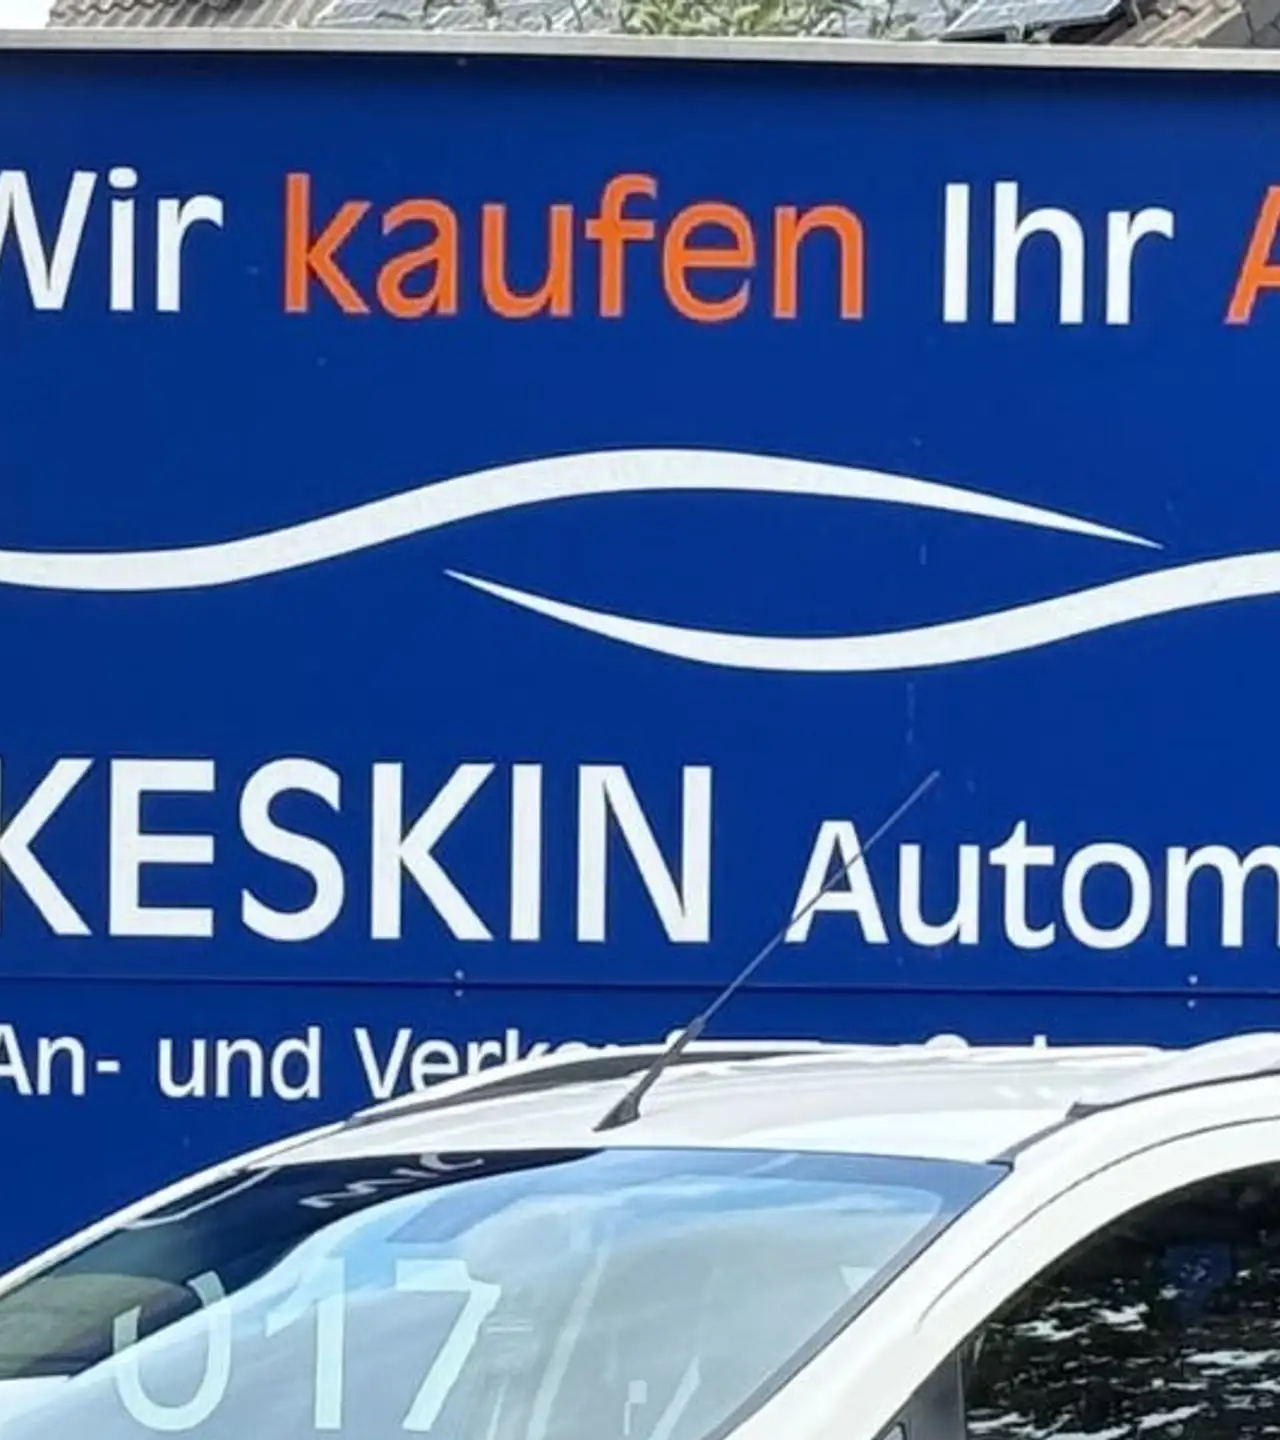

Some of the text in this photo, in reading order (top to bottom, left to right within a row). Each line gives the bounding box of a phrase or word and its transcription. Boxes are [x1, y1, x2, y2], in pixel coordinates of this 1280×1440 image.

[285, 173, 864, 322] kaufen
[943, 181, 1174, 325] Ihr
[159, 1026, 320, 1100] und
